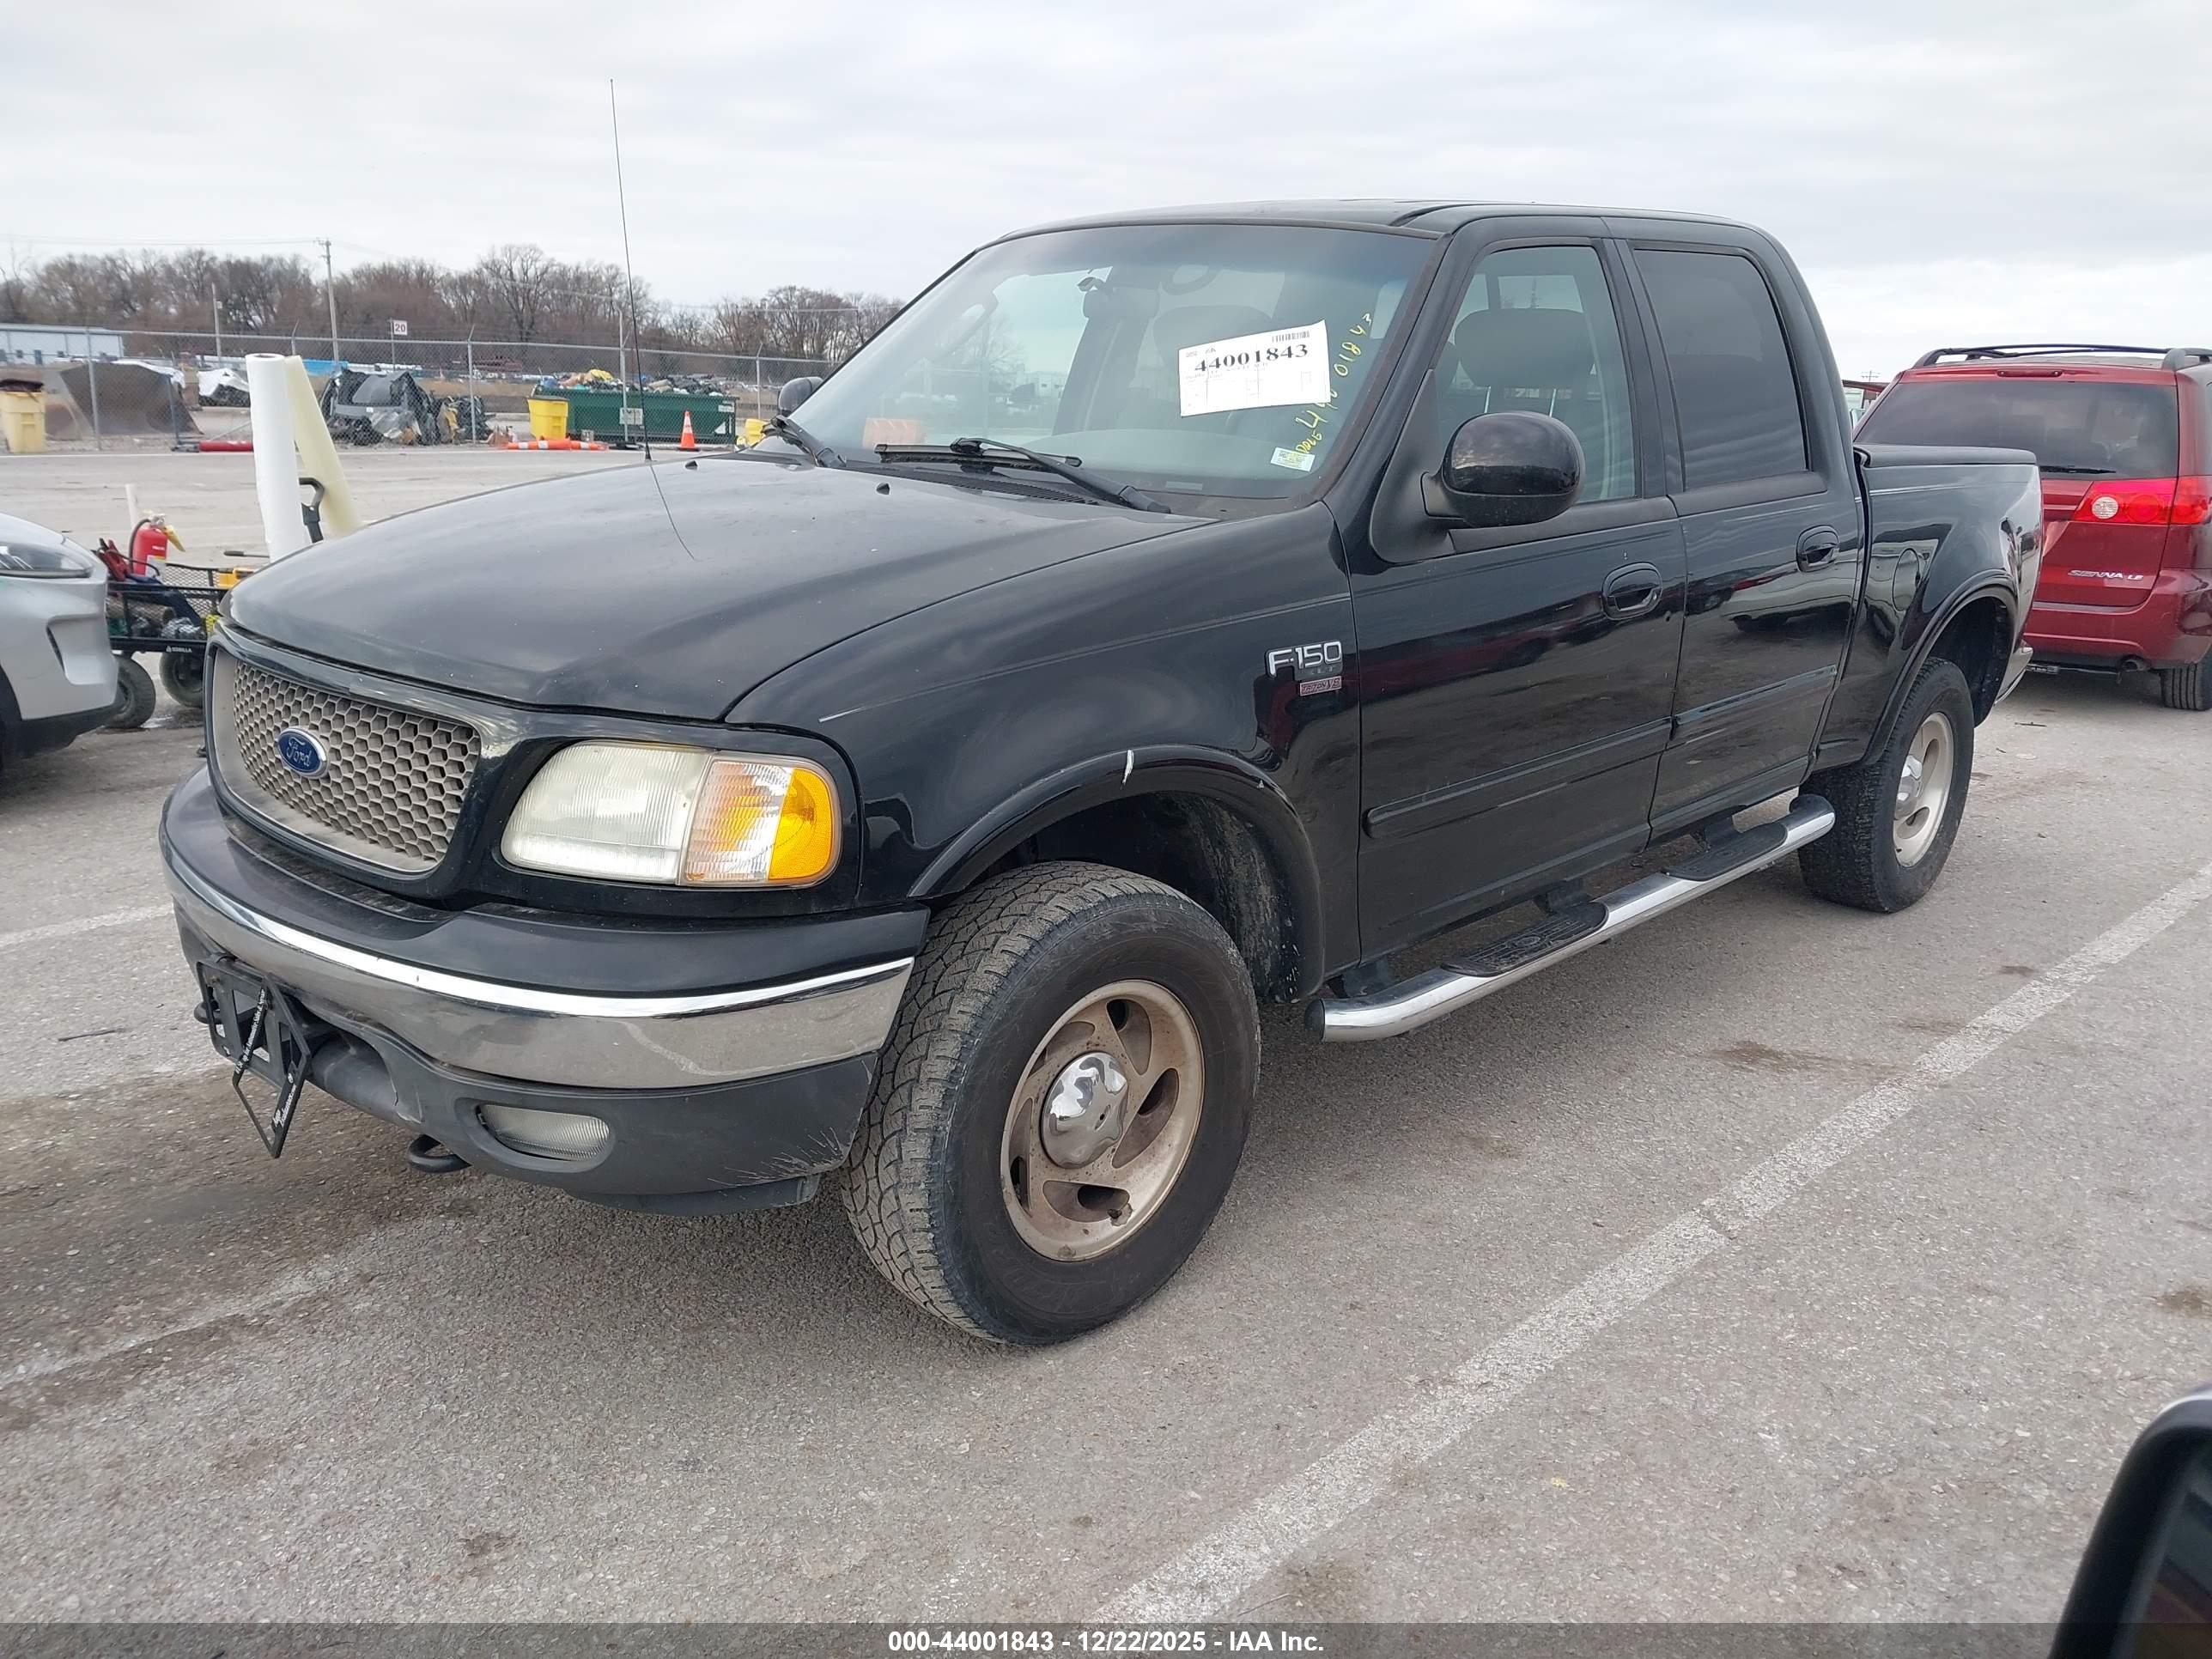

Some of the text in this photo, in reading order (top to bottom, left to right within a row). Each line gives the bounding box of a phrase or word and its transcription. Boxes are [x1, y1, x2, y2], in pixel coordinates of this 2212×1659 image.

[395, 323, 406, 332] 20
[1194, 343, 1309, 372] 44001843
[2068, 569, 2124, 579] SIENNA
[1268, 641, 1341, 678] F-150
[286, 737, 314, 767] Ford
